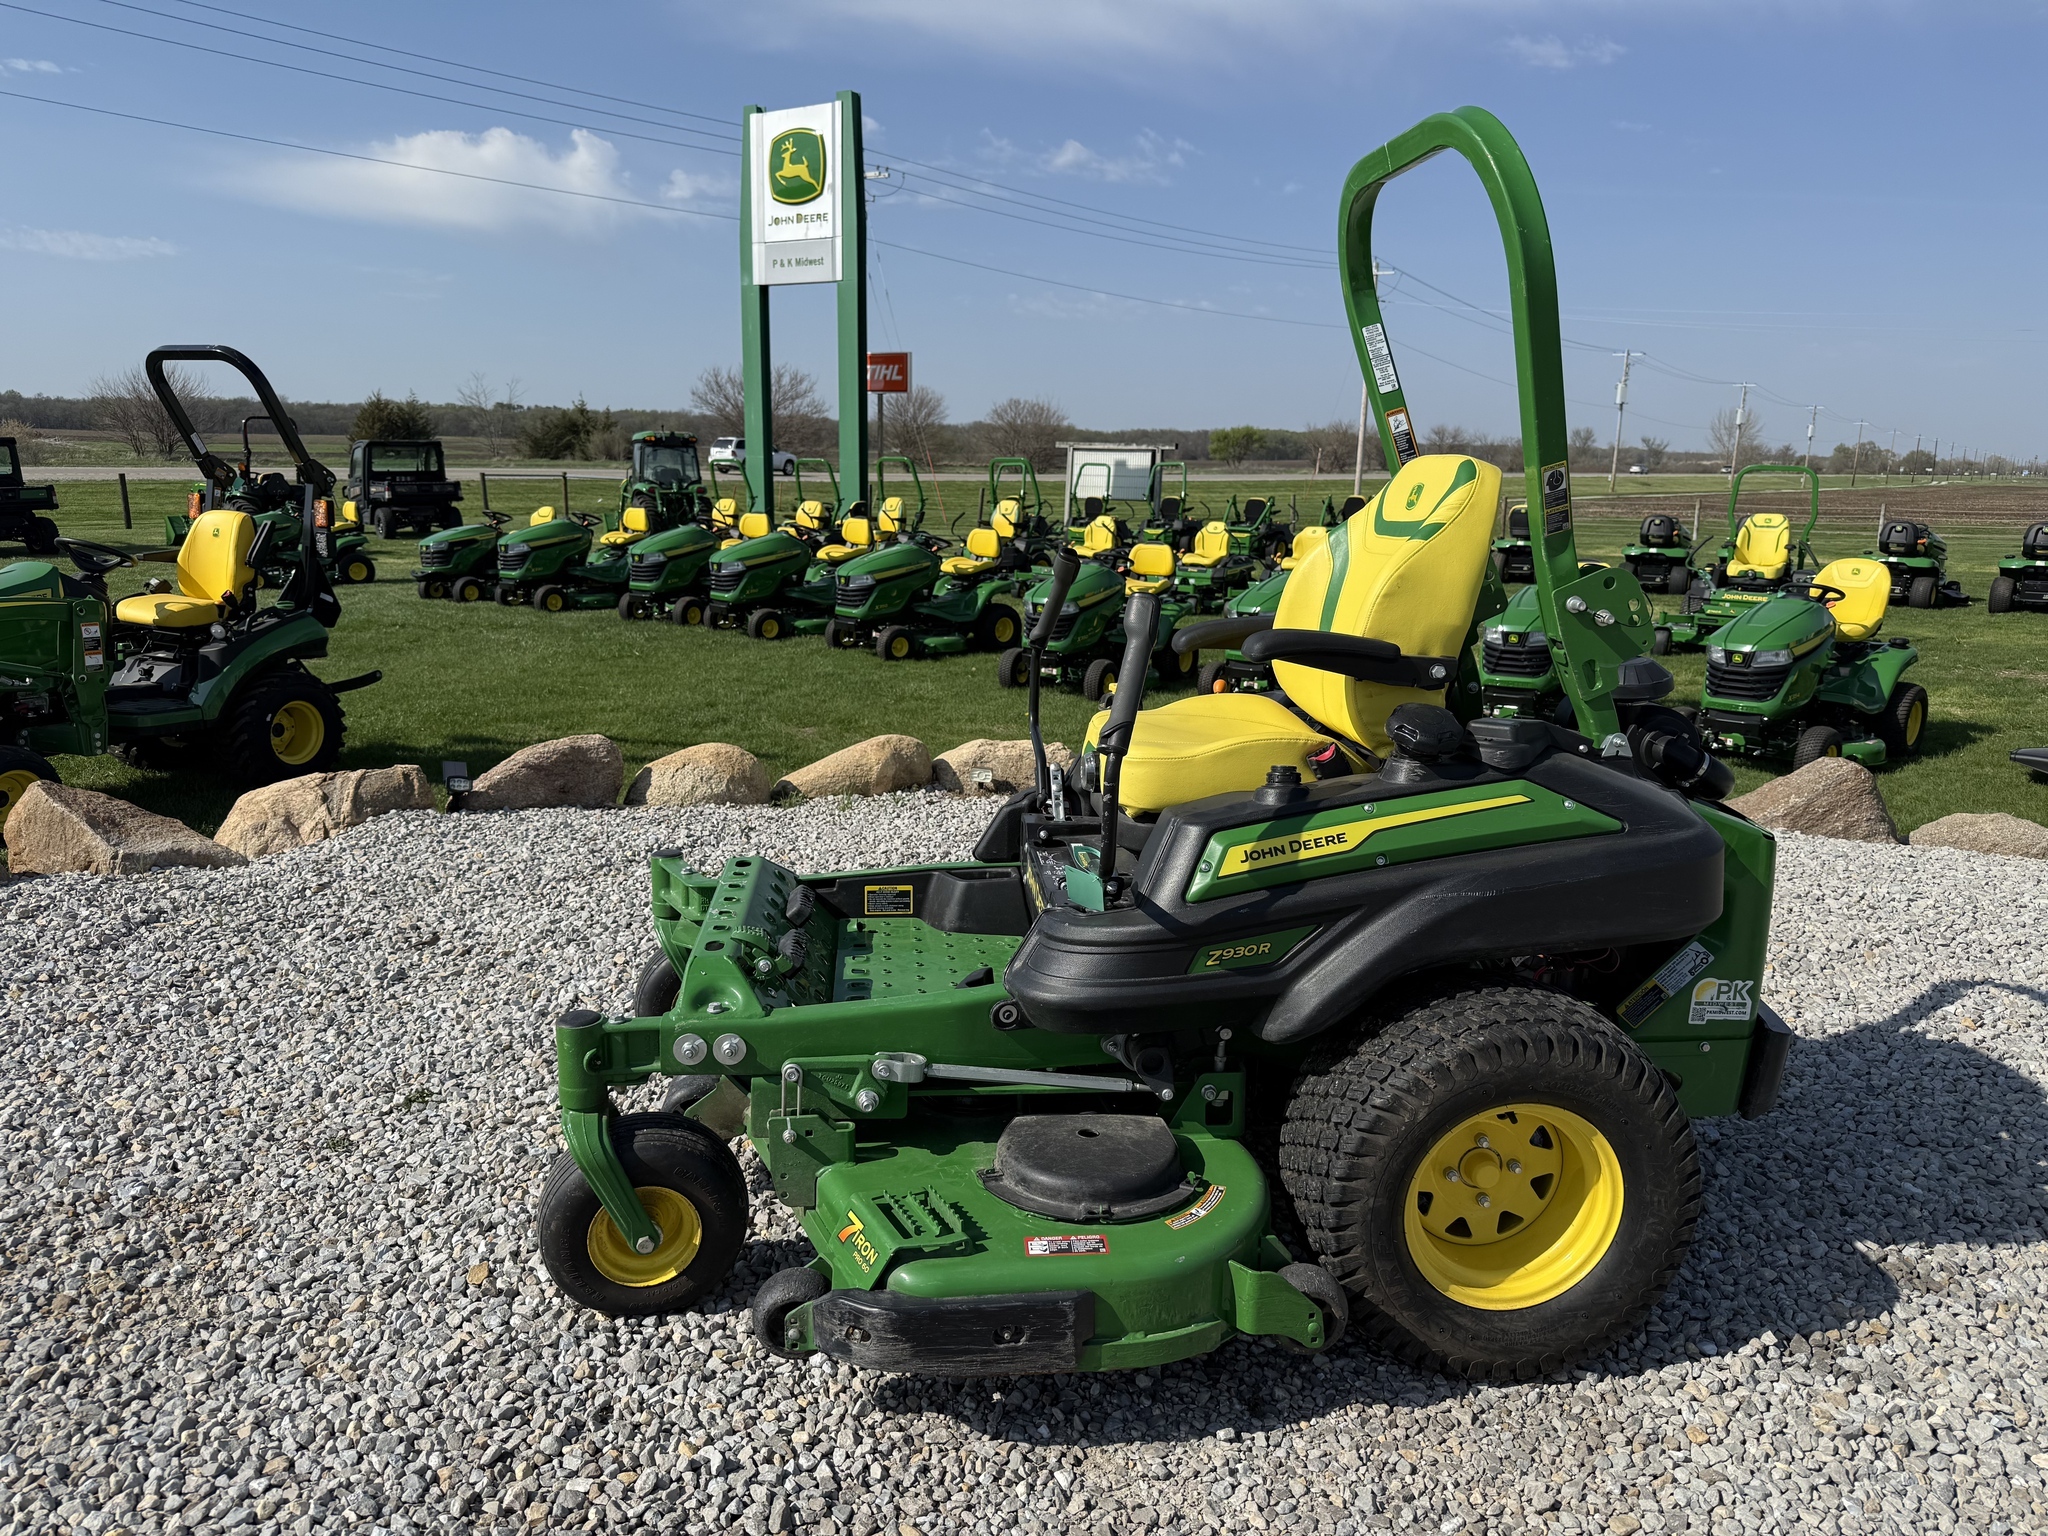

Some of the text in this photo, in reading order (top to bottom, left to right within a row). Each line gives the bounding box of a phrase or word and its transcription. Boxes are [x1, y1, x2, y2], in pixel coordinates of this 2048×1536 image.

[768, 212, 829, 227] JOHN DEERE
[772, 256, 824, 269] P & K Midwest
[867, 364, 903, 380] TIHL
[1743, 594, 1768, 602] DEERE
[1239, 832, 1348, 863] JOHN DEERE
[1206, 942, 1271, 966] Z930R
[852, 1251, 870, 1274] PRO 60
